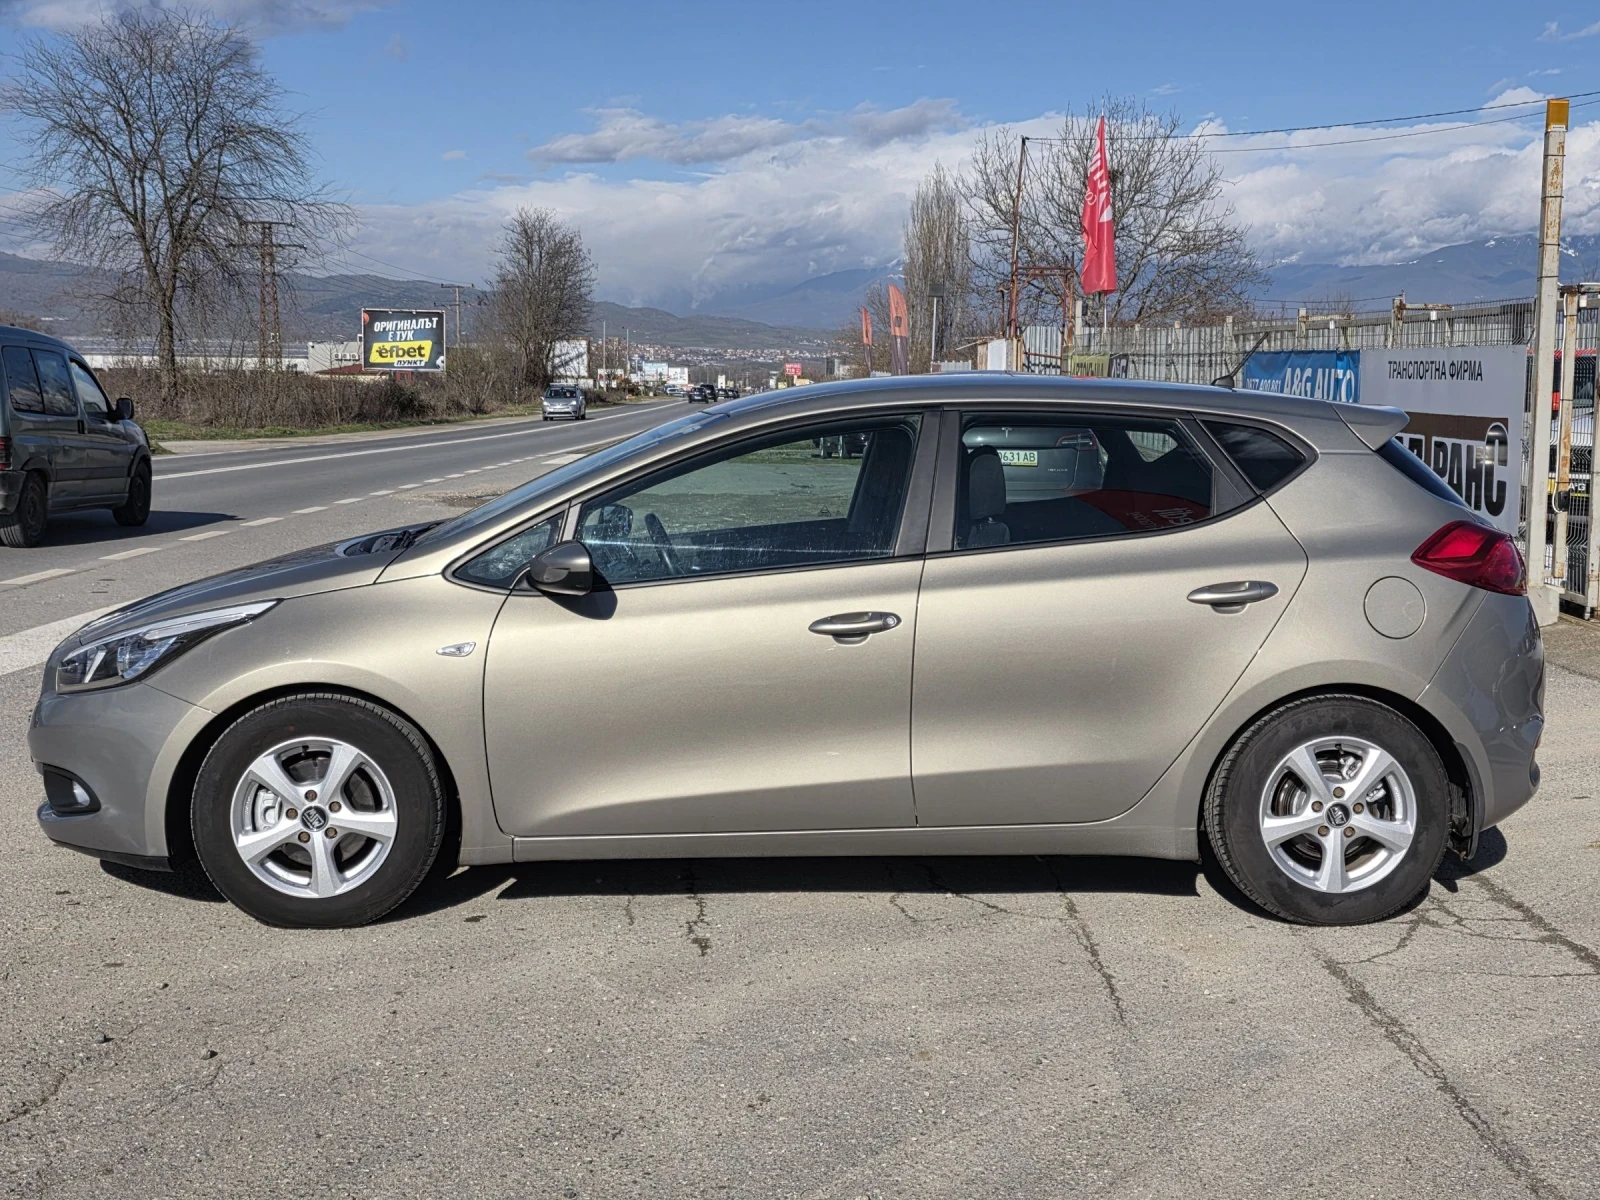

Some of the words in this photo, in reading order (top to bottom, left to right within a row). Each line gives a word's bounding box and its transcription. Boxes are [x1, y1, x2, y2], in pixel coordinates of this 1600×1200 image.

[374, 317, 438, 332] ОРИГИНАЛЪТ
[388, 332, 394, 341] Е
[396, 330, 414, 341] ТУК
[376, 344, 426, 359] efbet
[1388, 360, 1447, 380] ТРАНСПОРТНА
[1449, 360, 1483, 381] ФИРМА
[1284, 367, 1313, 398] A&G
[1314, 368, 1355, 403] AUTO
[1023, 452, 1036, 462] AB
